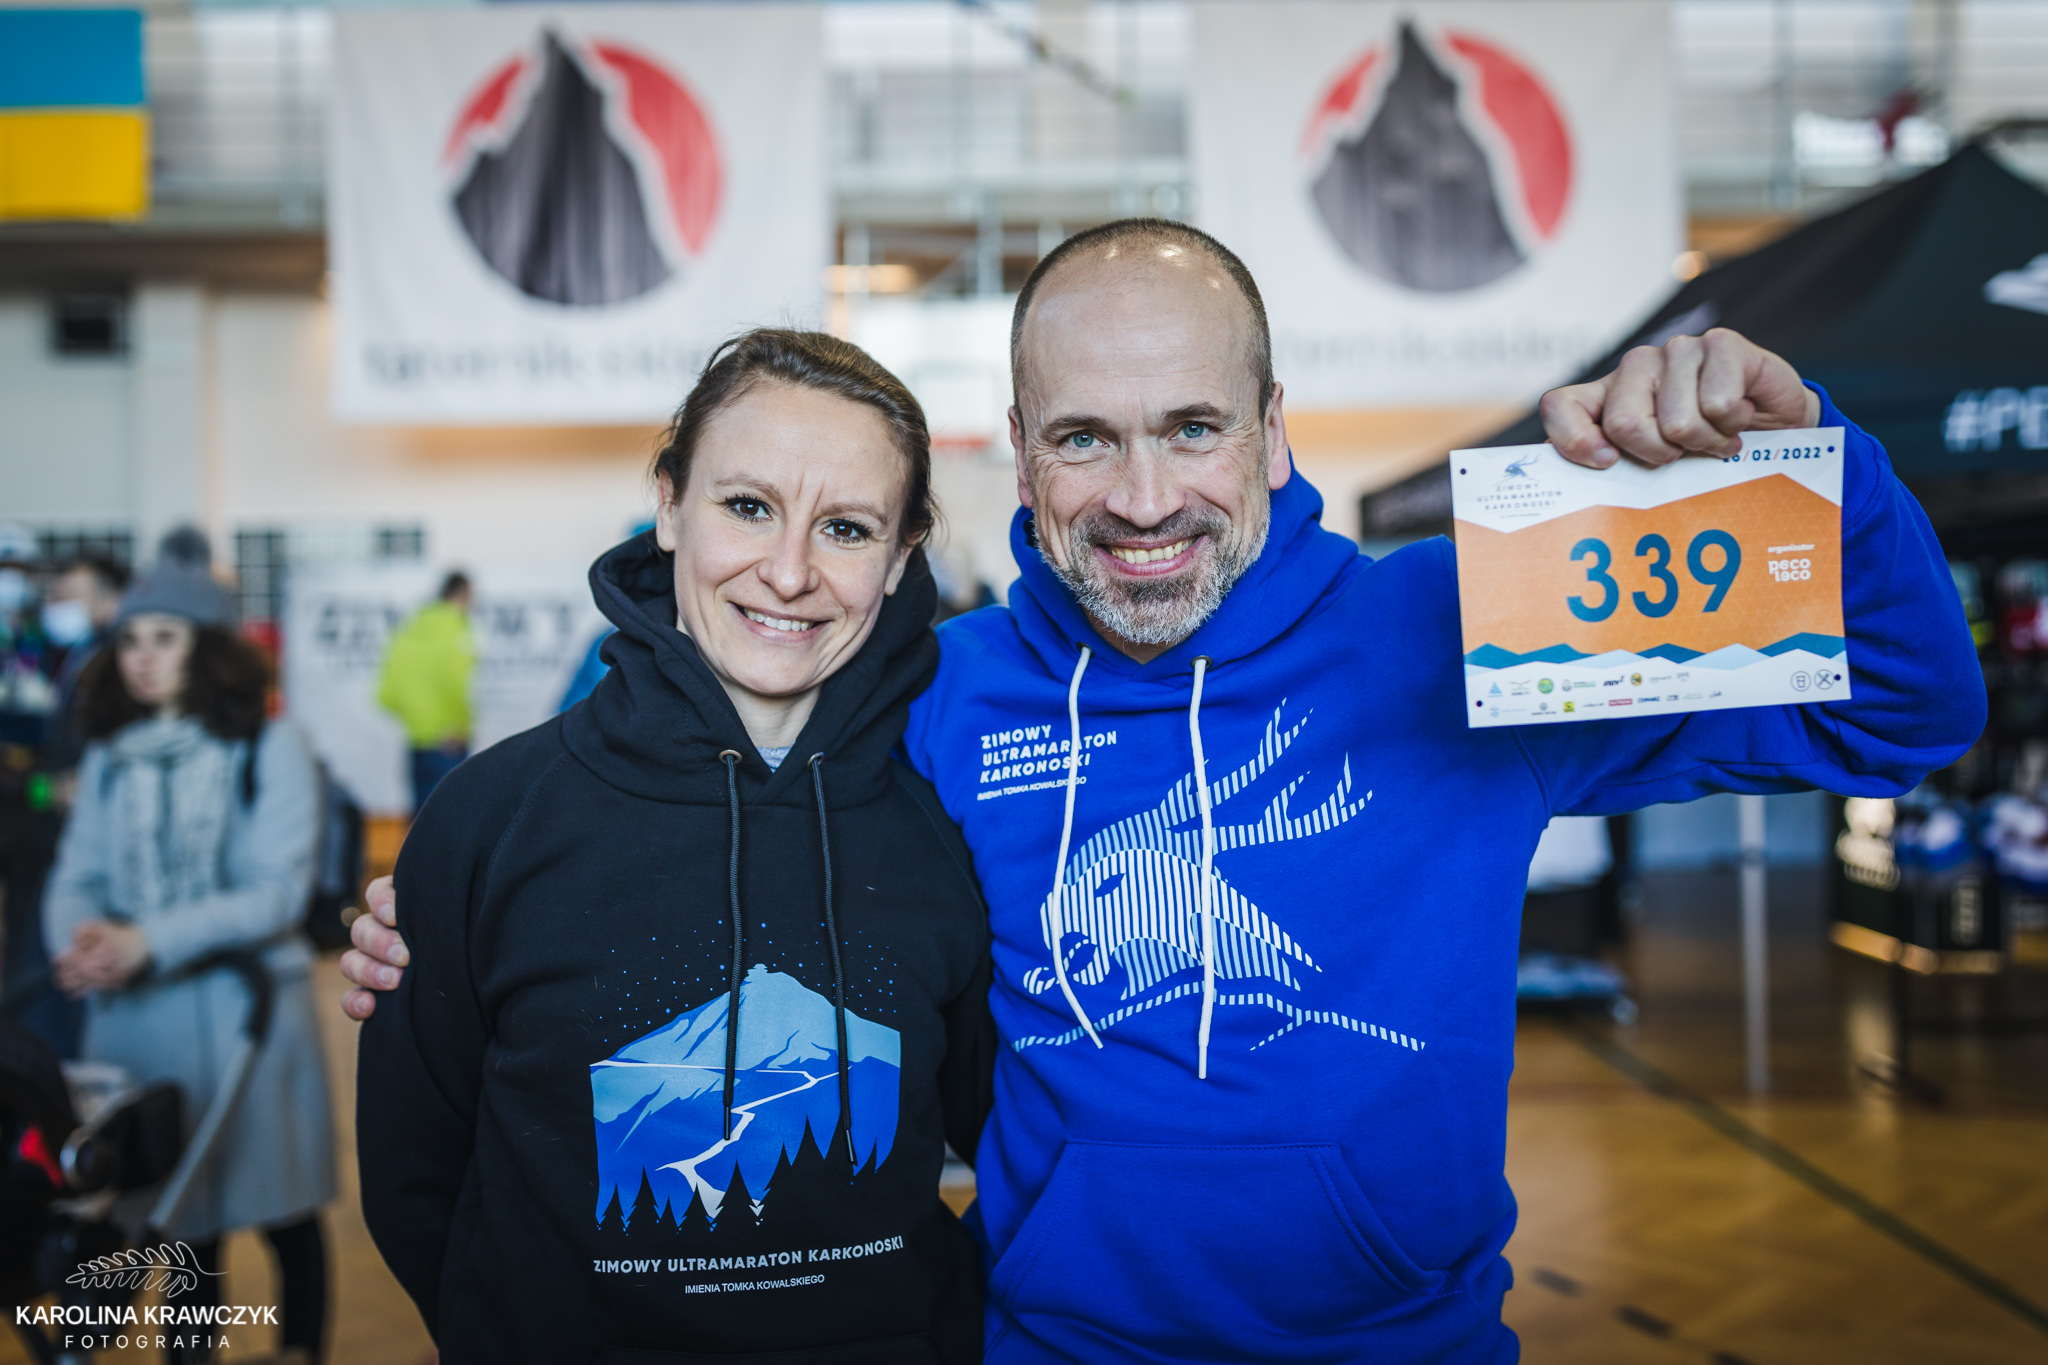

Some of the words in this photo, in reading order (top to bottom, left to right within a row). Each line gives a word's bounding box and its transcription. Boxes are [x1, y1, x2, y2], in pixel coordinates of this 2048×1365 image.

[1723, 446, 1822, 463] 6/02/2022
[1767, 544, 1816, 555] organizator
[1566, 529, 1742, 623] 339
[981, 724, 1052, 750] ZIMOWY
[979, 752, 1091, 784] KARKONOSKI
[593, 1259, 662, 1274] ZIMOWY
[667, 1250, 802, 1272] ULTRAMARATON
[808, 1235, 904, 1263] KARKONOSKI
[685, 1283, 720, 1294] IMIENIA
[722, 1280, 755, 1292] TOMKA
[756, 1274, 825, 1291] KOWALSKIEGO
